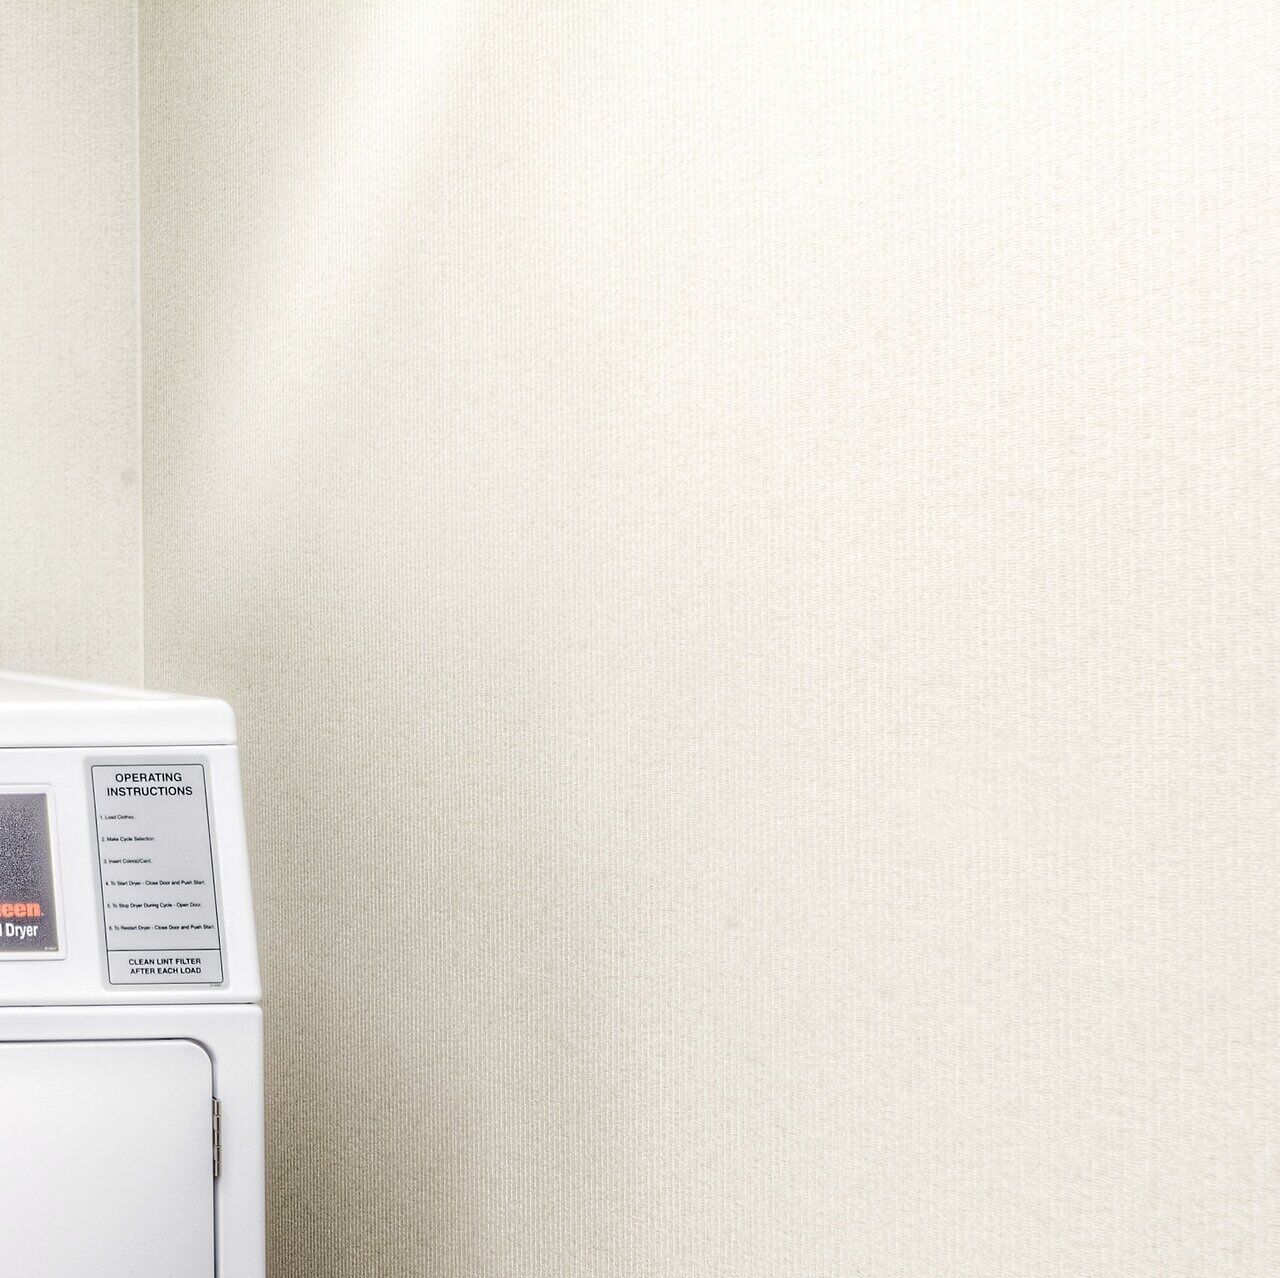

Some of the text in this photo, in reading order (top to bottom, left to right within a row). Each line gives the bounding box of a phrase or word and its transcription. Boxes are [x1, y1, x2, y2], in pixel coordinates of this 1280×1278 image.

[115, 772, 182, 782] OPERATING
[107, 786, 193, 796] INSTRUCTIONS
[5, 922, 38, 939] Dryer
